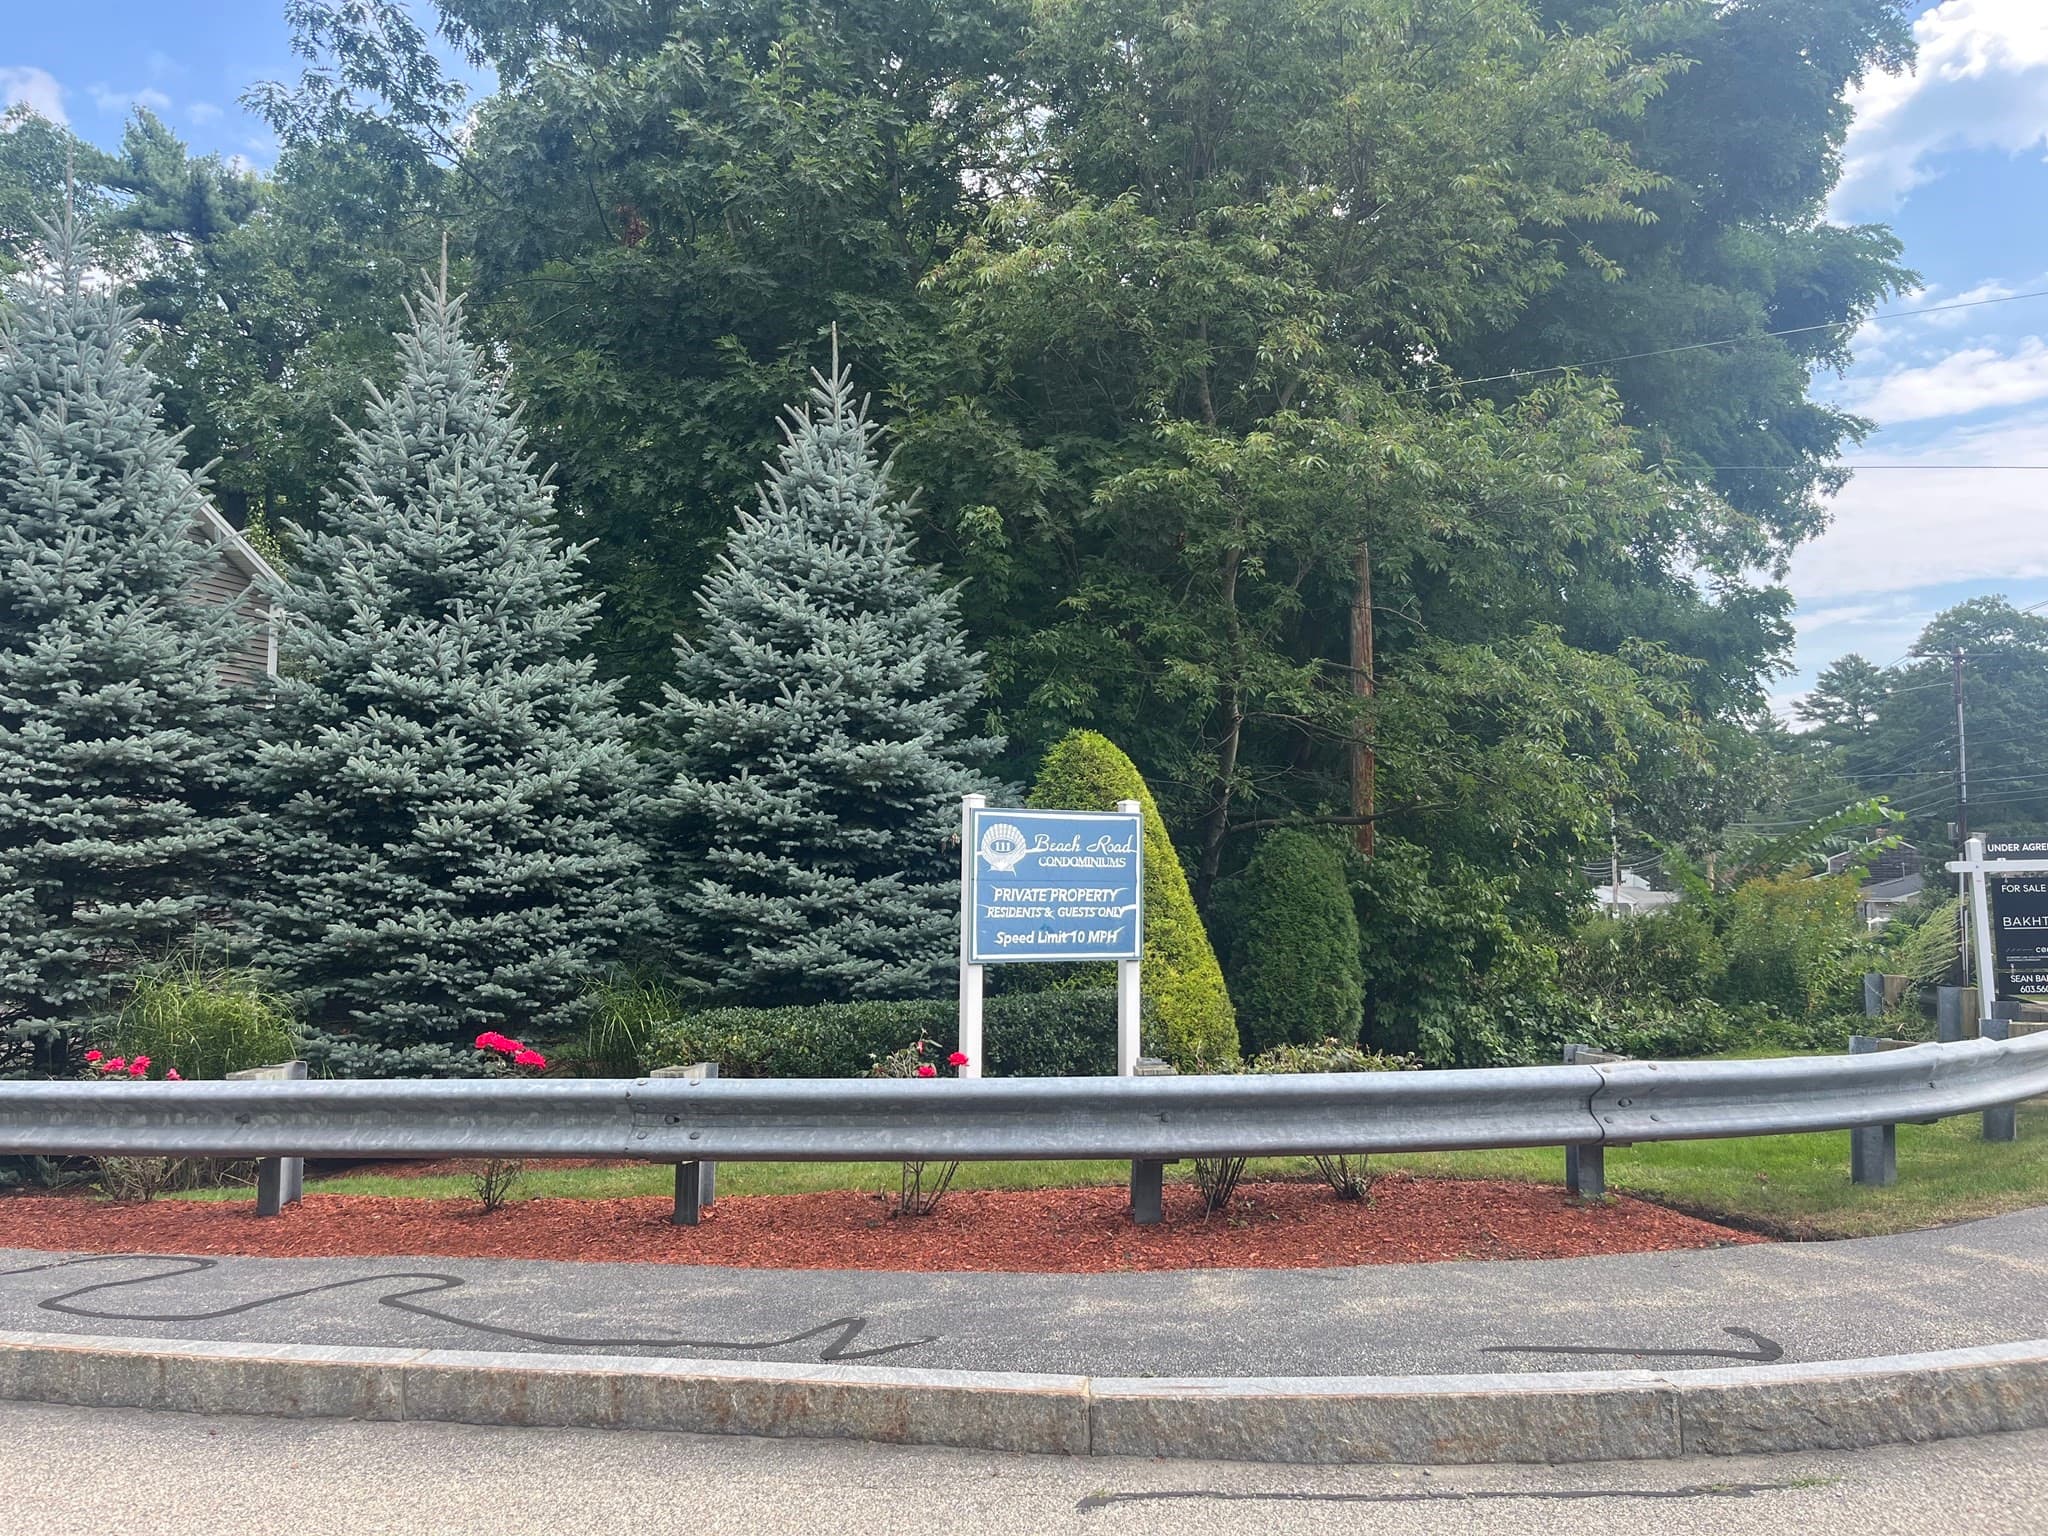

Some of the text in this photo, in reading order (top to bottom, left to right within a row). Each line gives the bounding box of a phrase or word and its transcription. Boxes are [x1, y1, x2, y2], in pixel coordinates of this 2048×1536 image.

[995, 842, 1011, 852] 111
[1034, 834, 1135, 855] Beach Road
[1987, 843, 2048, 852] UNDER AGRE
[1039, 856, 1126, 868] CONDOMINIUMS
[2001, 884, 2047, 893] FOR SALE
[994, 888, 1118, 902] PRIVATE PROPERTY
[987, 905, 1123, 919] RESIDENTS & GUESTS ONLY
[2003, 916, 2048, 927] BAKHT
[996, 929, 1118, 947] Speed Limit 10 MPH
[2010, 974, 2033, 983] SEAN
